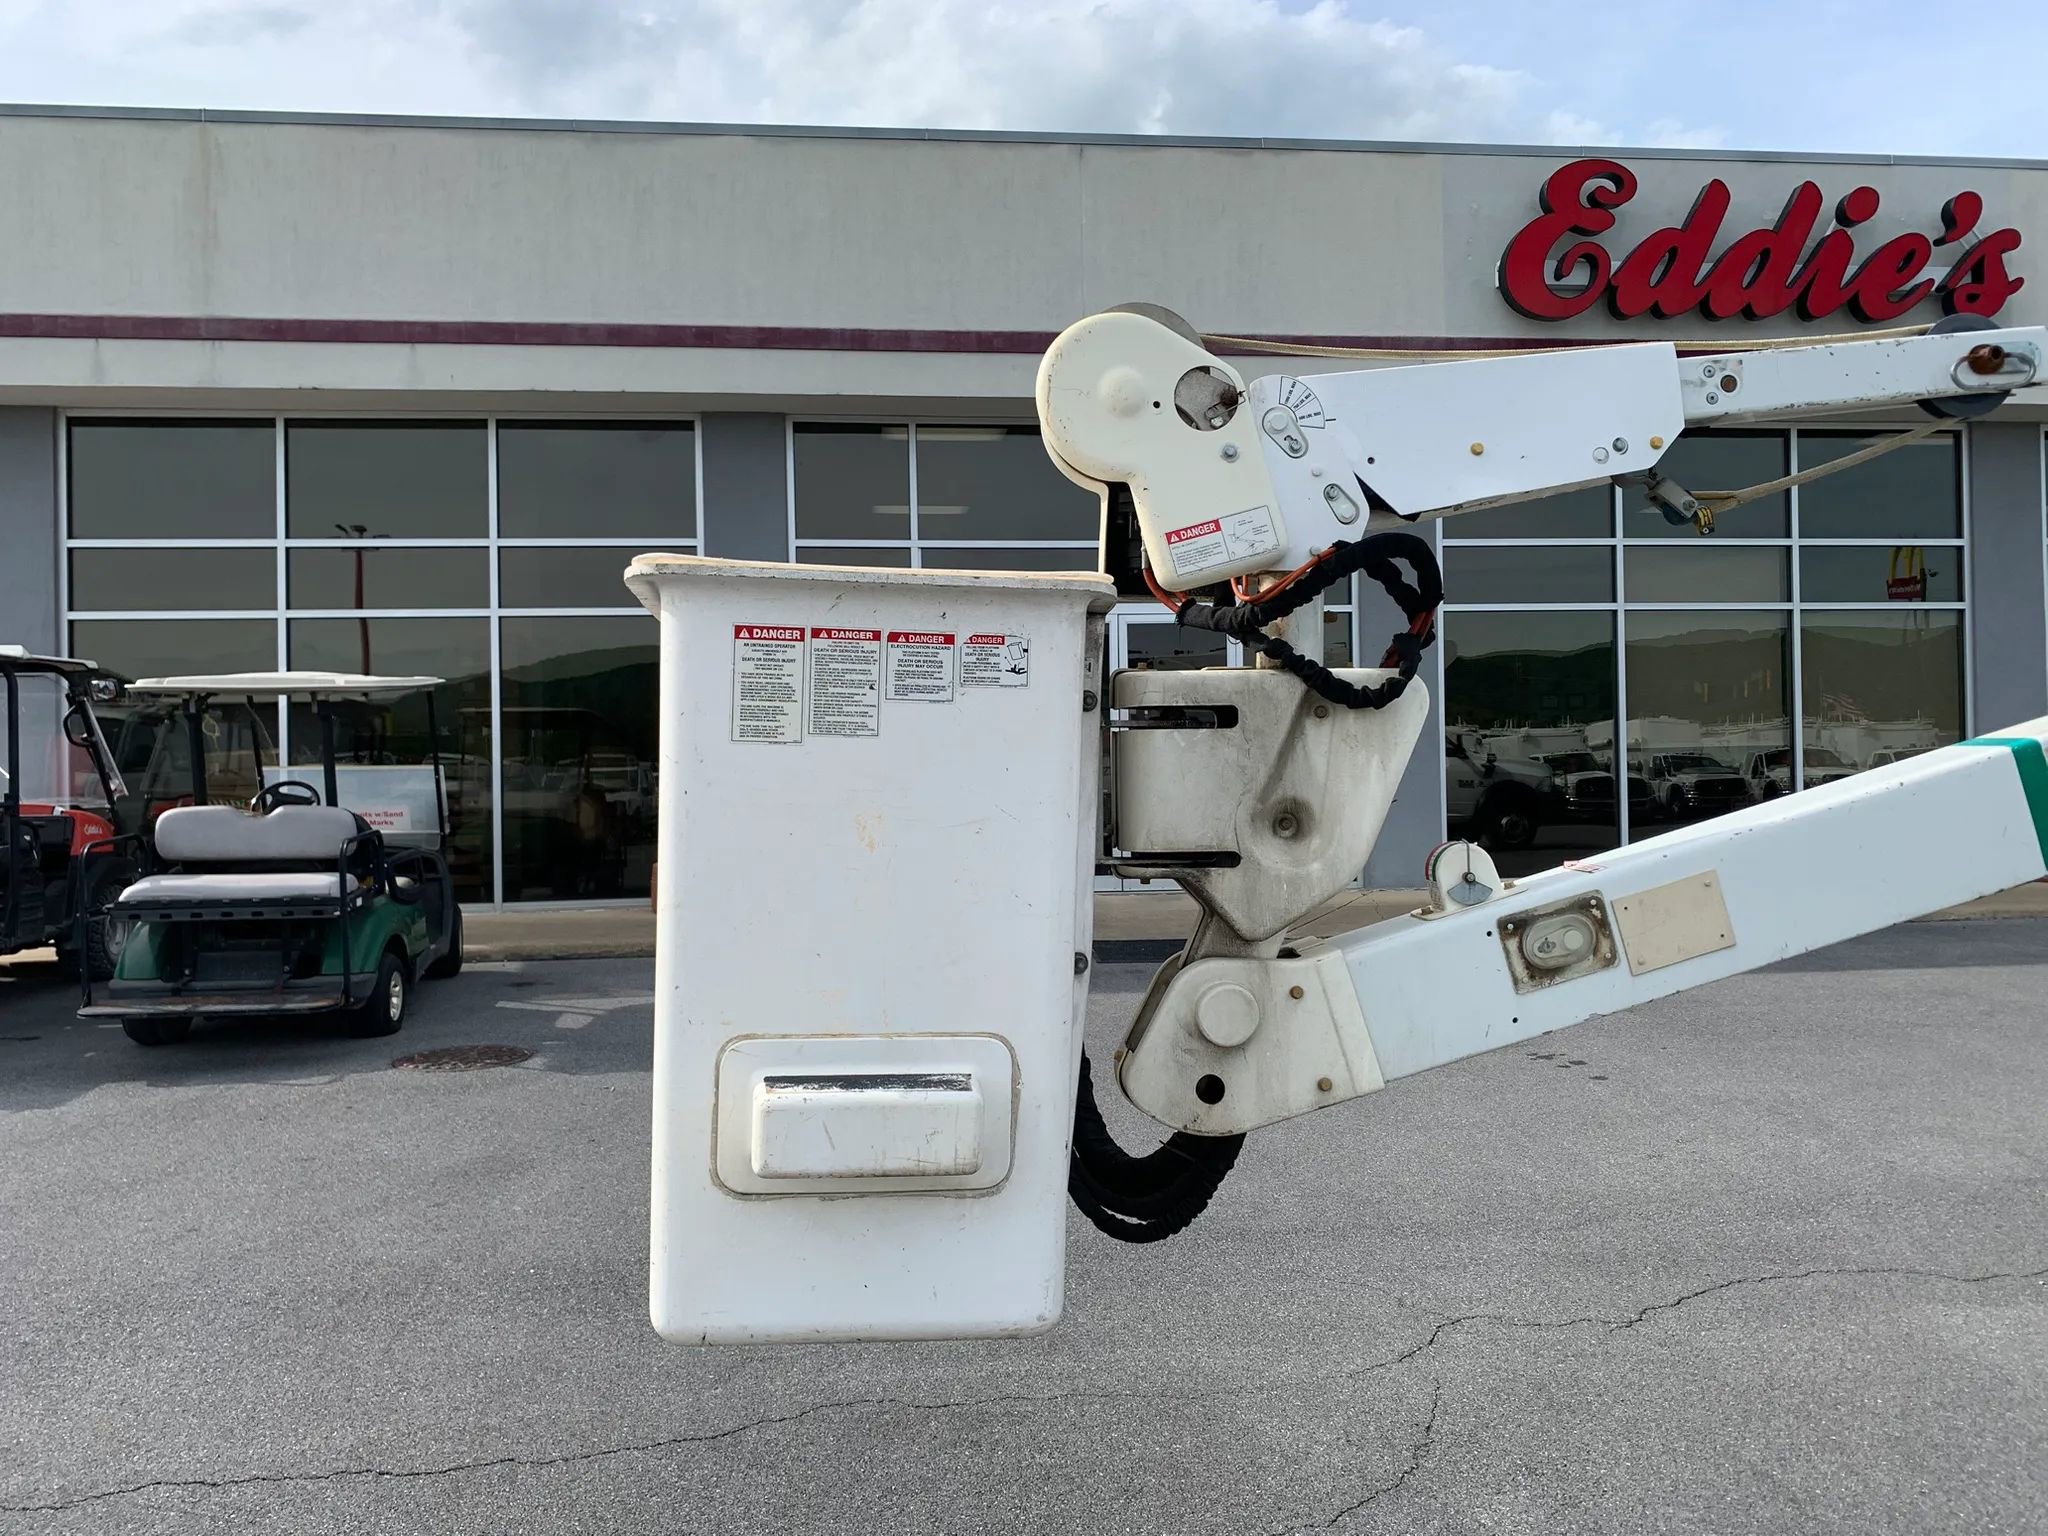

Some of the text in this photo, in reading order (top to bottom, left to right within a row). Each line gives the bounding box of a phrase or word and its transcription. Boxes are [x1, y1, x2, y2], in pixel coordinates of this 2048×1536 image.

[1499, 158, 2025, 323] Eddie's
[1180, 522, 1217, 540] DANGER
[752, 628, 801, 640] DANGER
[831, 630, 873, 639] DANGER
[908, 634, 945, 644] DANGER
[971, 636, 1003, 644] DANGER
